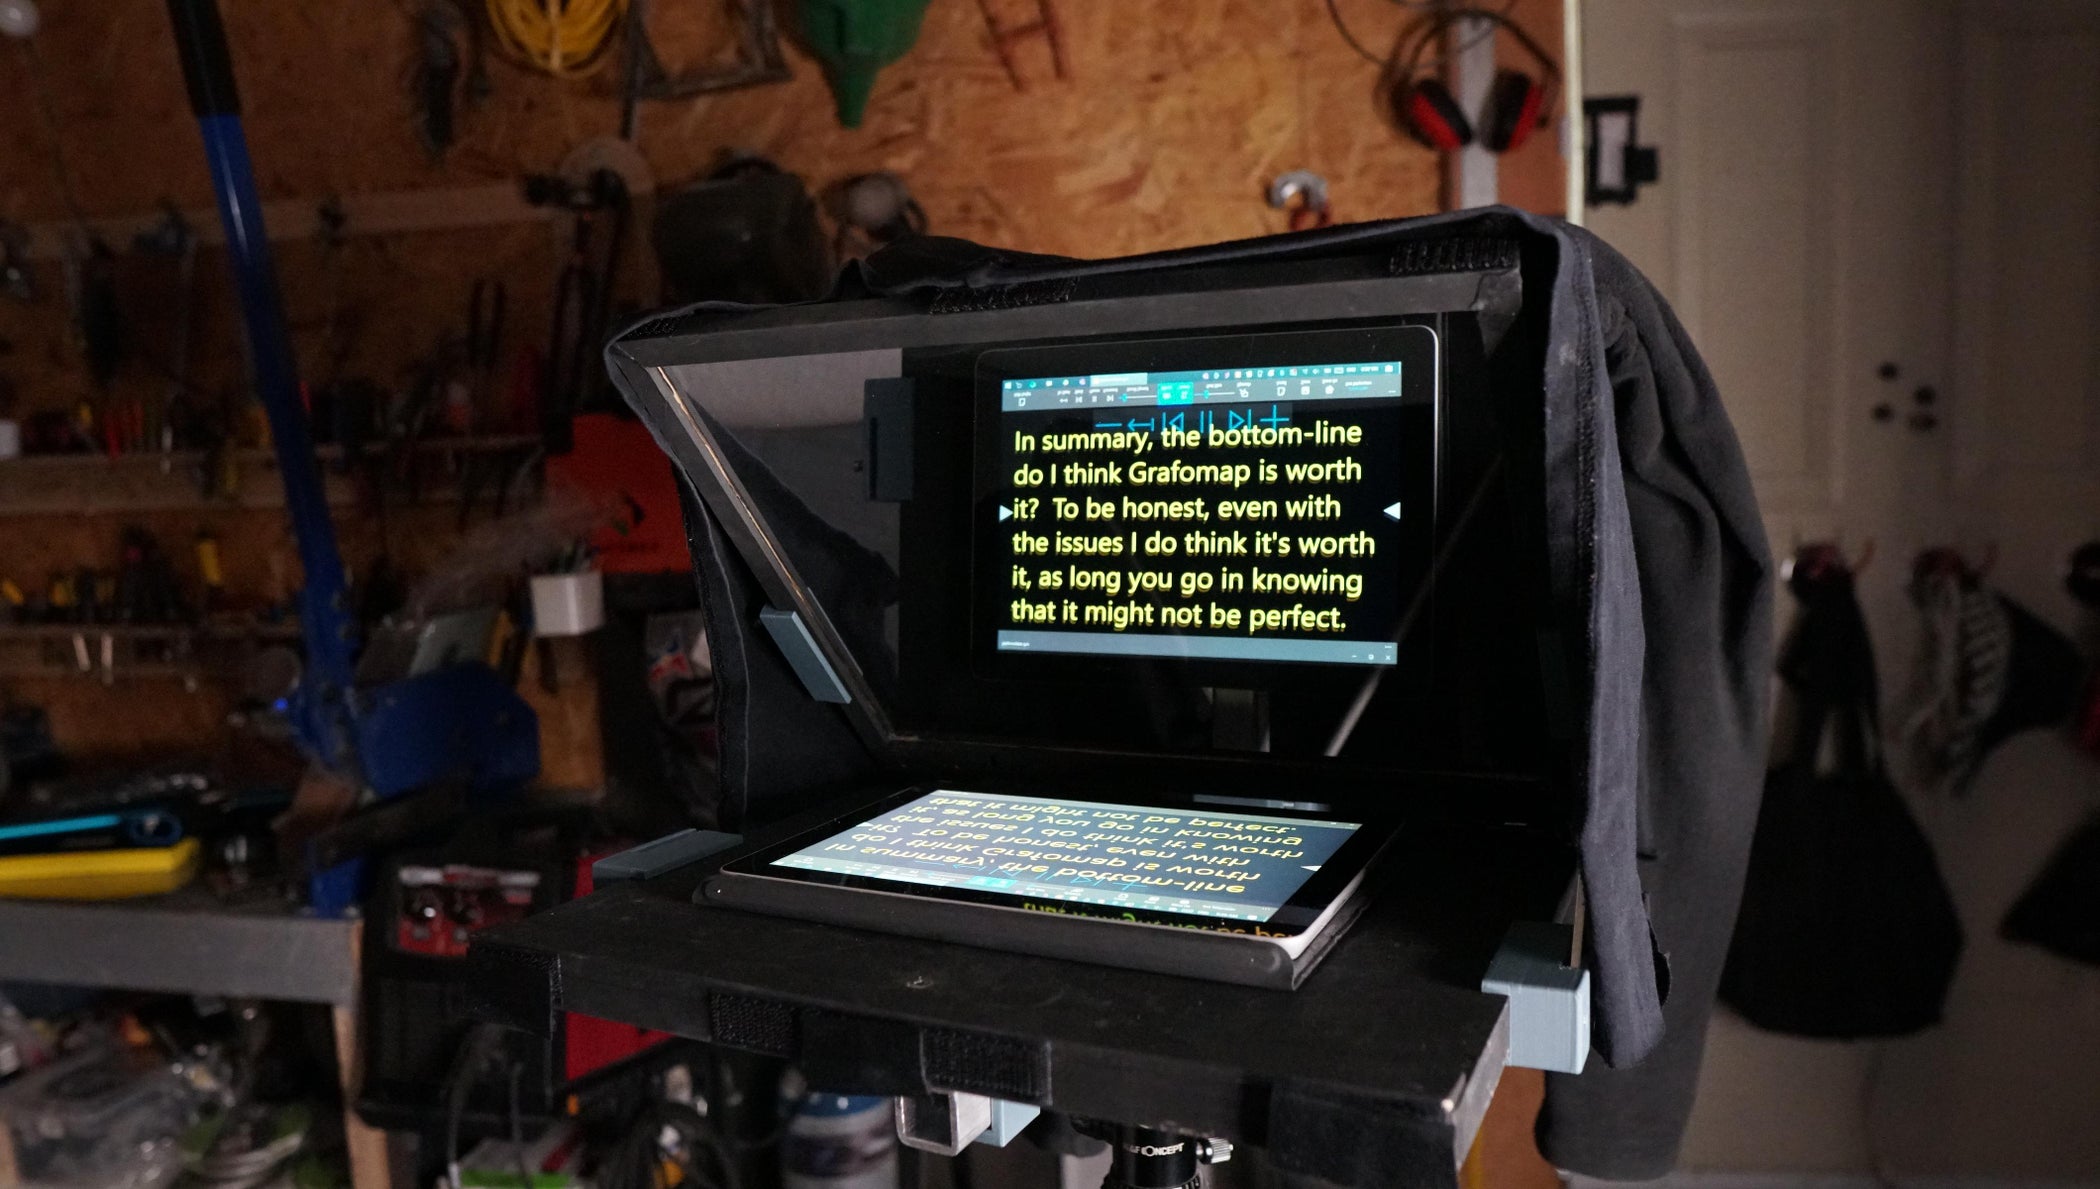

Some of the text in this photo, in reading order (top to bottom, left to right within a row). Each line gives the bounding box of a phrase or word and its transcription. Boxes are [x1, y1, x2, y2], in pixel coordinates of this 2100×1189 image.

[1015, 420, 1362, 454] In summary, the bottom-line
[1014, 456, 1362, 488] do I think Grafomap is worth
[1013, 494, 1341, 522] it? To be honest, even with
[1012, 530, 1375, 556] the issues I do think it's worth
[1012, 564, 1362, 599] it, as long you go in knowing
[1011, 598, 1346, 633] that it might not be perfect.
